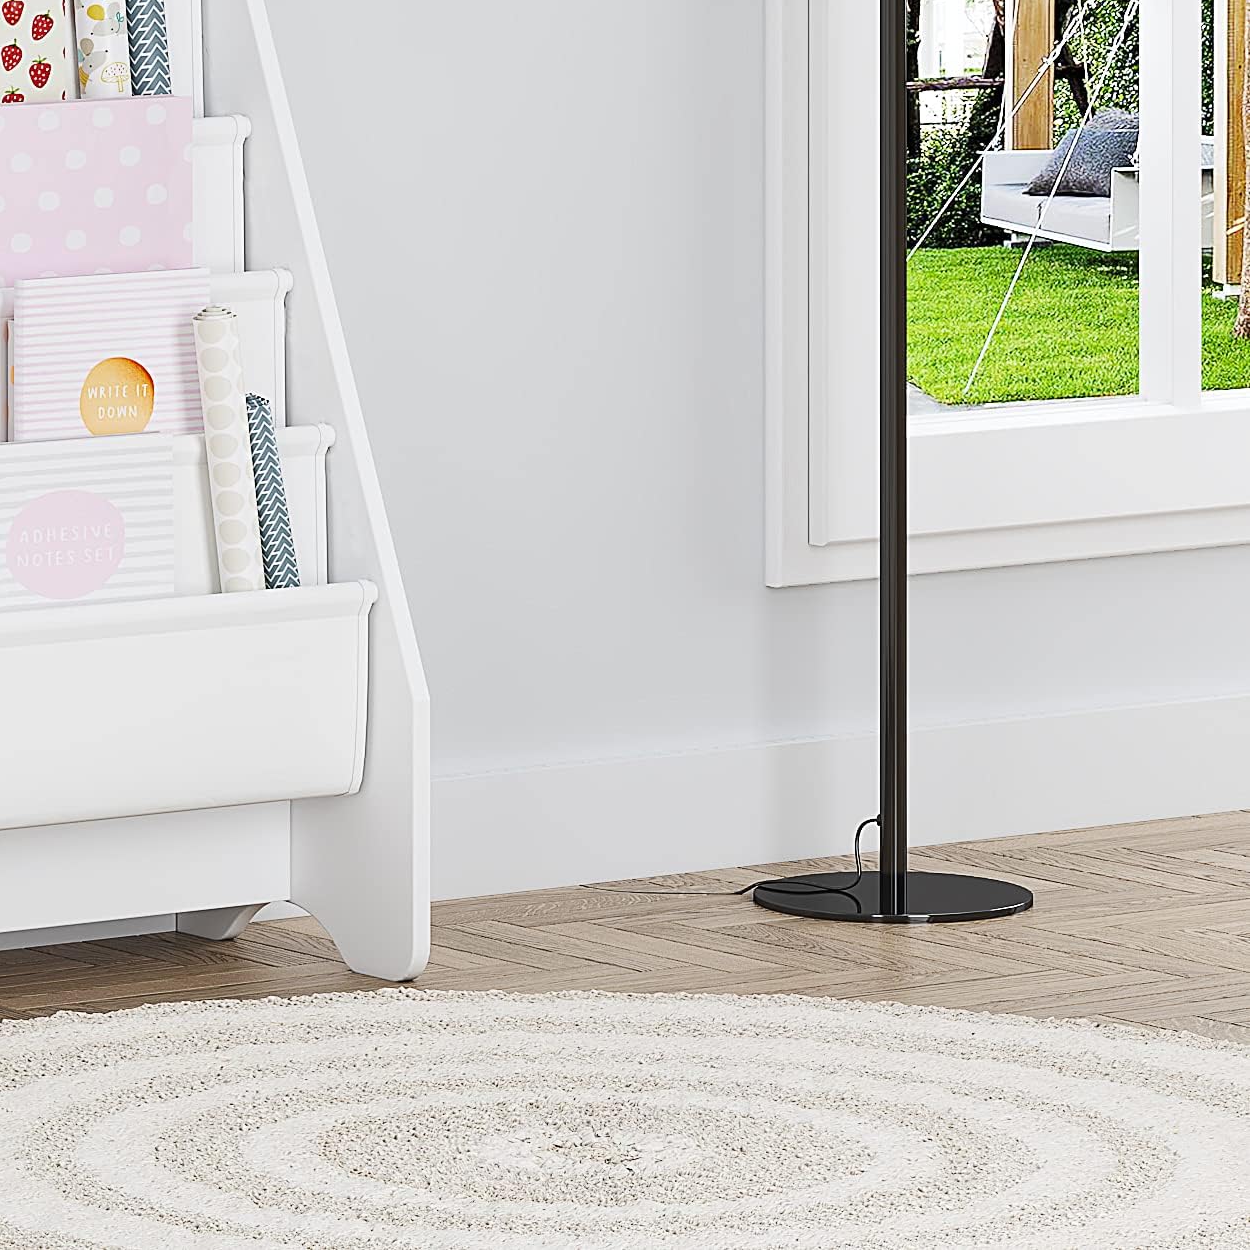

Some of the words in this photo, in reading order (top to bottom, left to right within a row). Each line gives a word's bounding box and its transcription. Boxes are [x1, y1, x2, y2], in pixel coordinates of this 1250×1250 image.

[87, 384, 129, 399] WRITE
[136, 383, 149, 398] IT
[98, 405, 138, 420] DOWN
[20, 522, 111, 543] ADHESIVE
[16, 550, 76, 567] NOTES
[84, 546, 116, 563] SET
